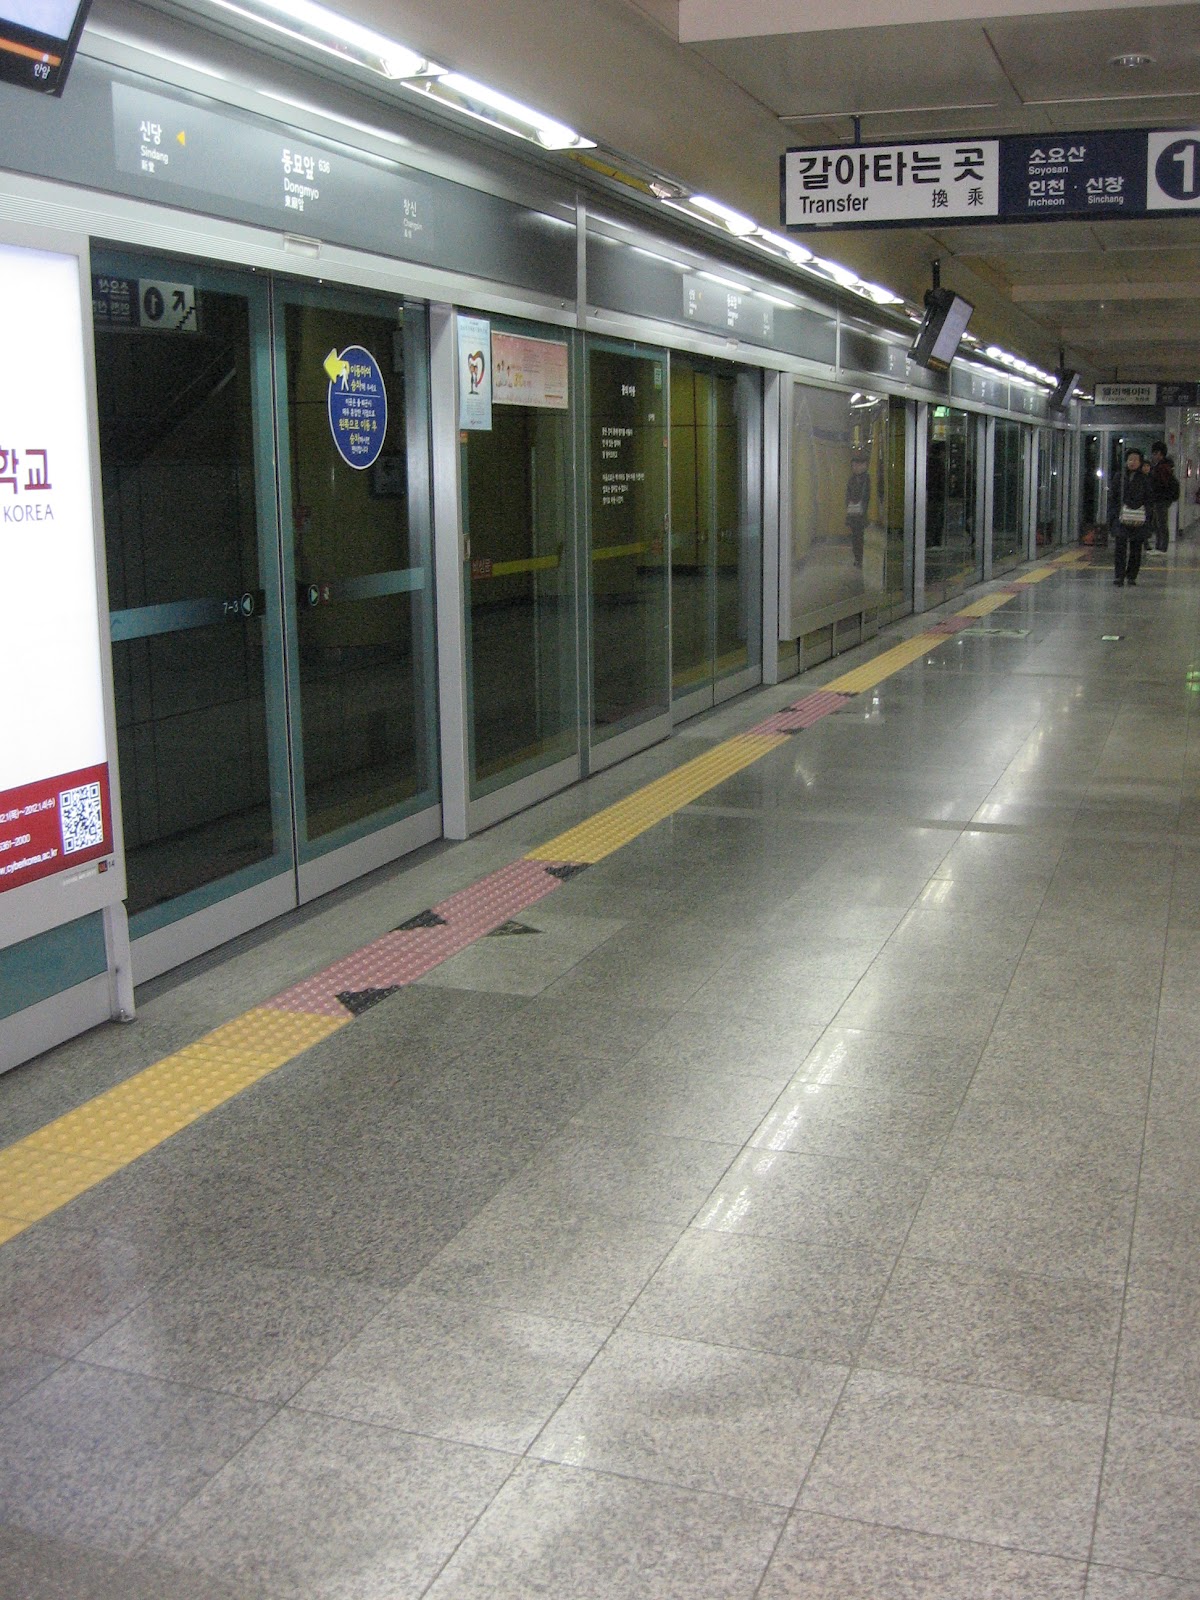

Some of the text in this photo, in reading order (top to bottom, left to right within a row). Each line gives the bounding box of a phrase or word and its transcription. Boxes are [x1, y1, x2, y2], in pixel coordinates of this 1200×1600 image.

[34, 64, 50, 79] 안암
[140, 120, 162, 145] 신당
[140, 145, 168, 165] Sindang
[1028, 146, 1086, 164] 소요산
[281, 149, 331, 181] 동묘앞 636
[799, 147, 985, 190] 갈아타는 곳
[1028, 166, 1069, 176] Soyosan
[1173, 144, 1195, 193] 1
[284, 177, 319, 201] Dongmyo
[1028, 176, 1124, 197] 인천 신창
[403, 199, 417, 218] 창신
[799, 193, 869, 214] Transfer
[1028, 194, 1124, 207] Incheon Sinchang
[350, 364, 372, 378] 이동하여
[339, 418, 378, 432] 왼쪽으로 이동 후
[3, 504, 55, 523] KOREA
[222, 600, 239, 614] 7-3
